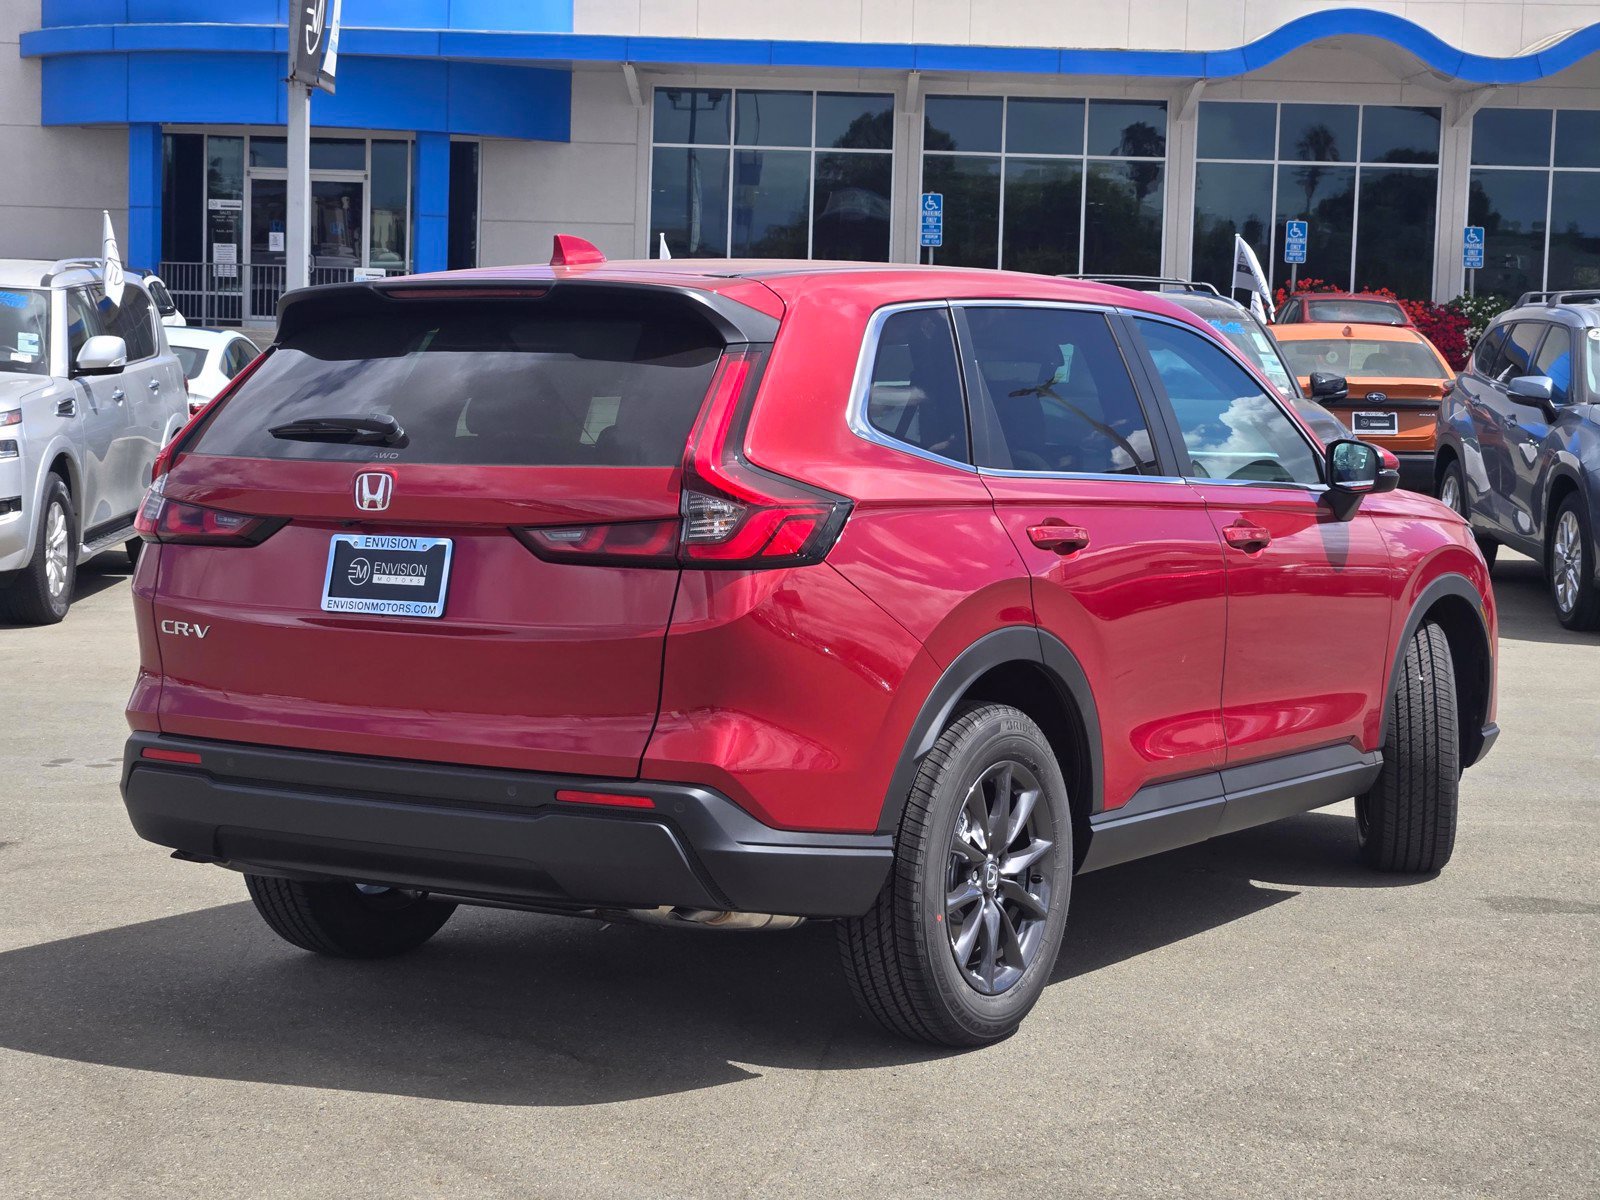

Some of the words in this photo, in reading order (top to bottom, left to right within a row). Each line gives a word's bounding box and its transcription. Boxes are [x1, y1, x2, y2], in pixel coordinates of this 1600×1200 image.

[364, 537, 418, 549] ENVISION
[373, 561, 428, 576] ENVISION
[376, 576, 421, 584] MOTORS
[327, 600, 437, 615] ENVISIONMOTORS.COM
[161, 619, 211, 639] CR-V
